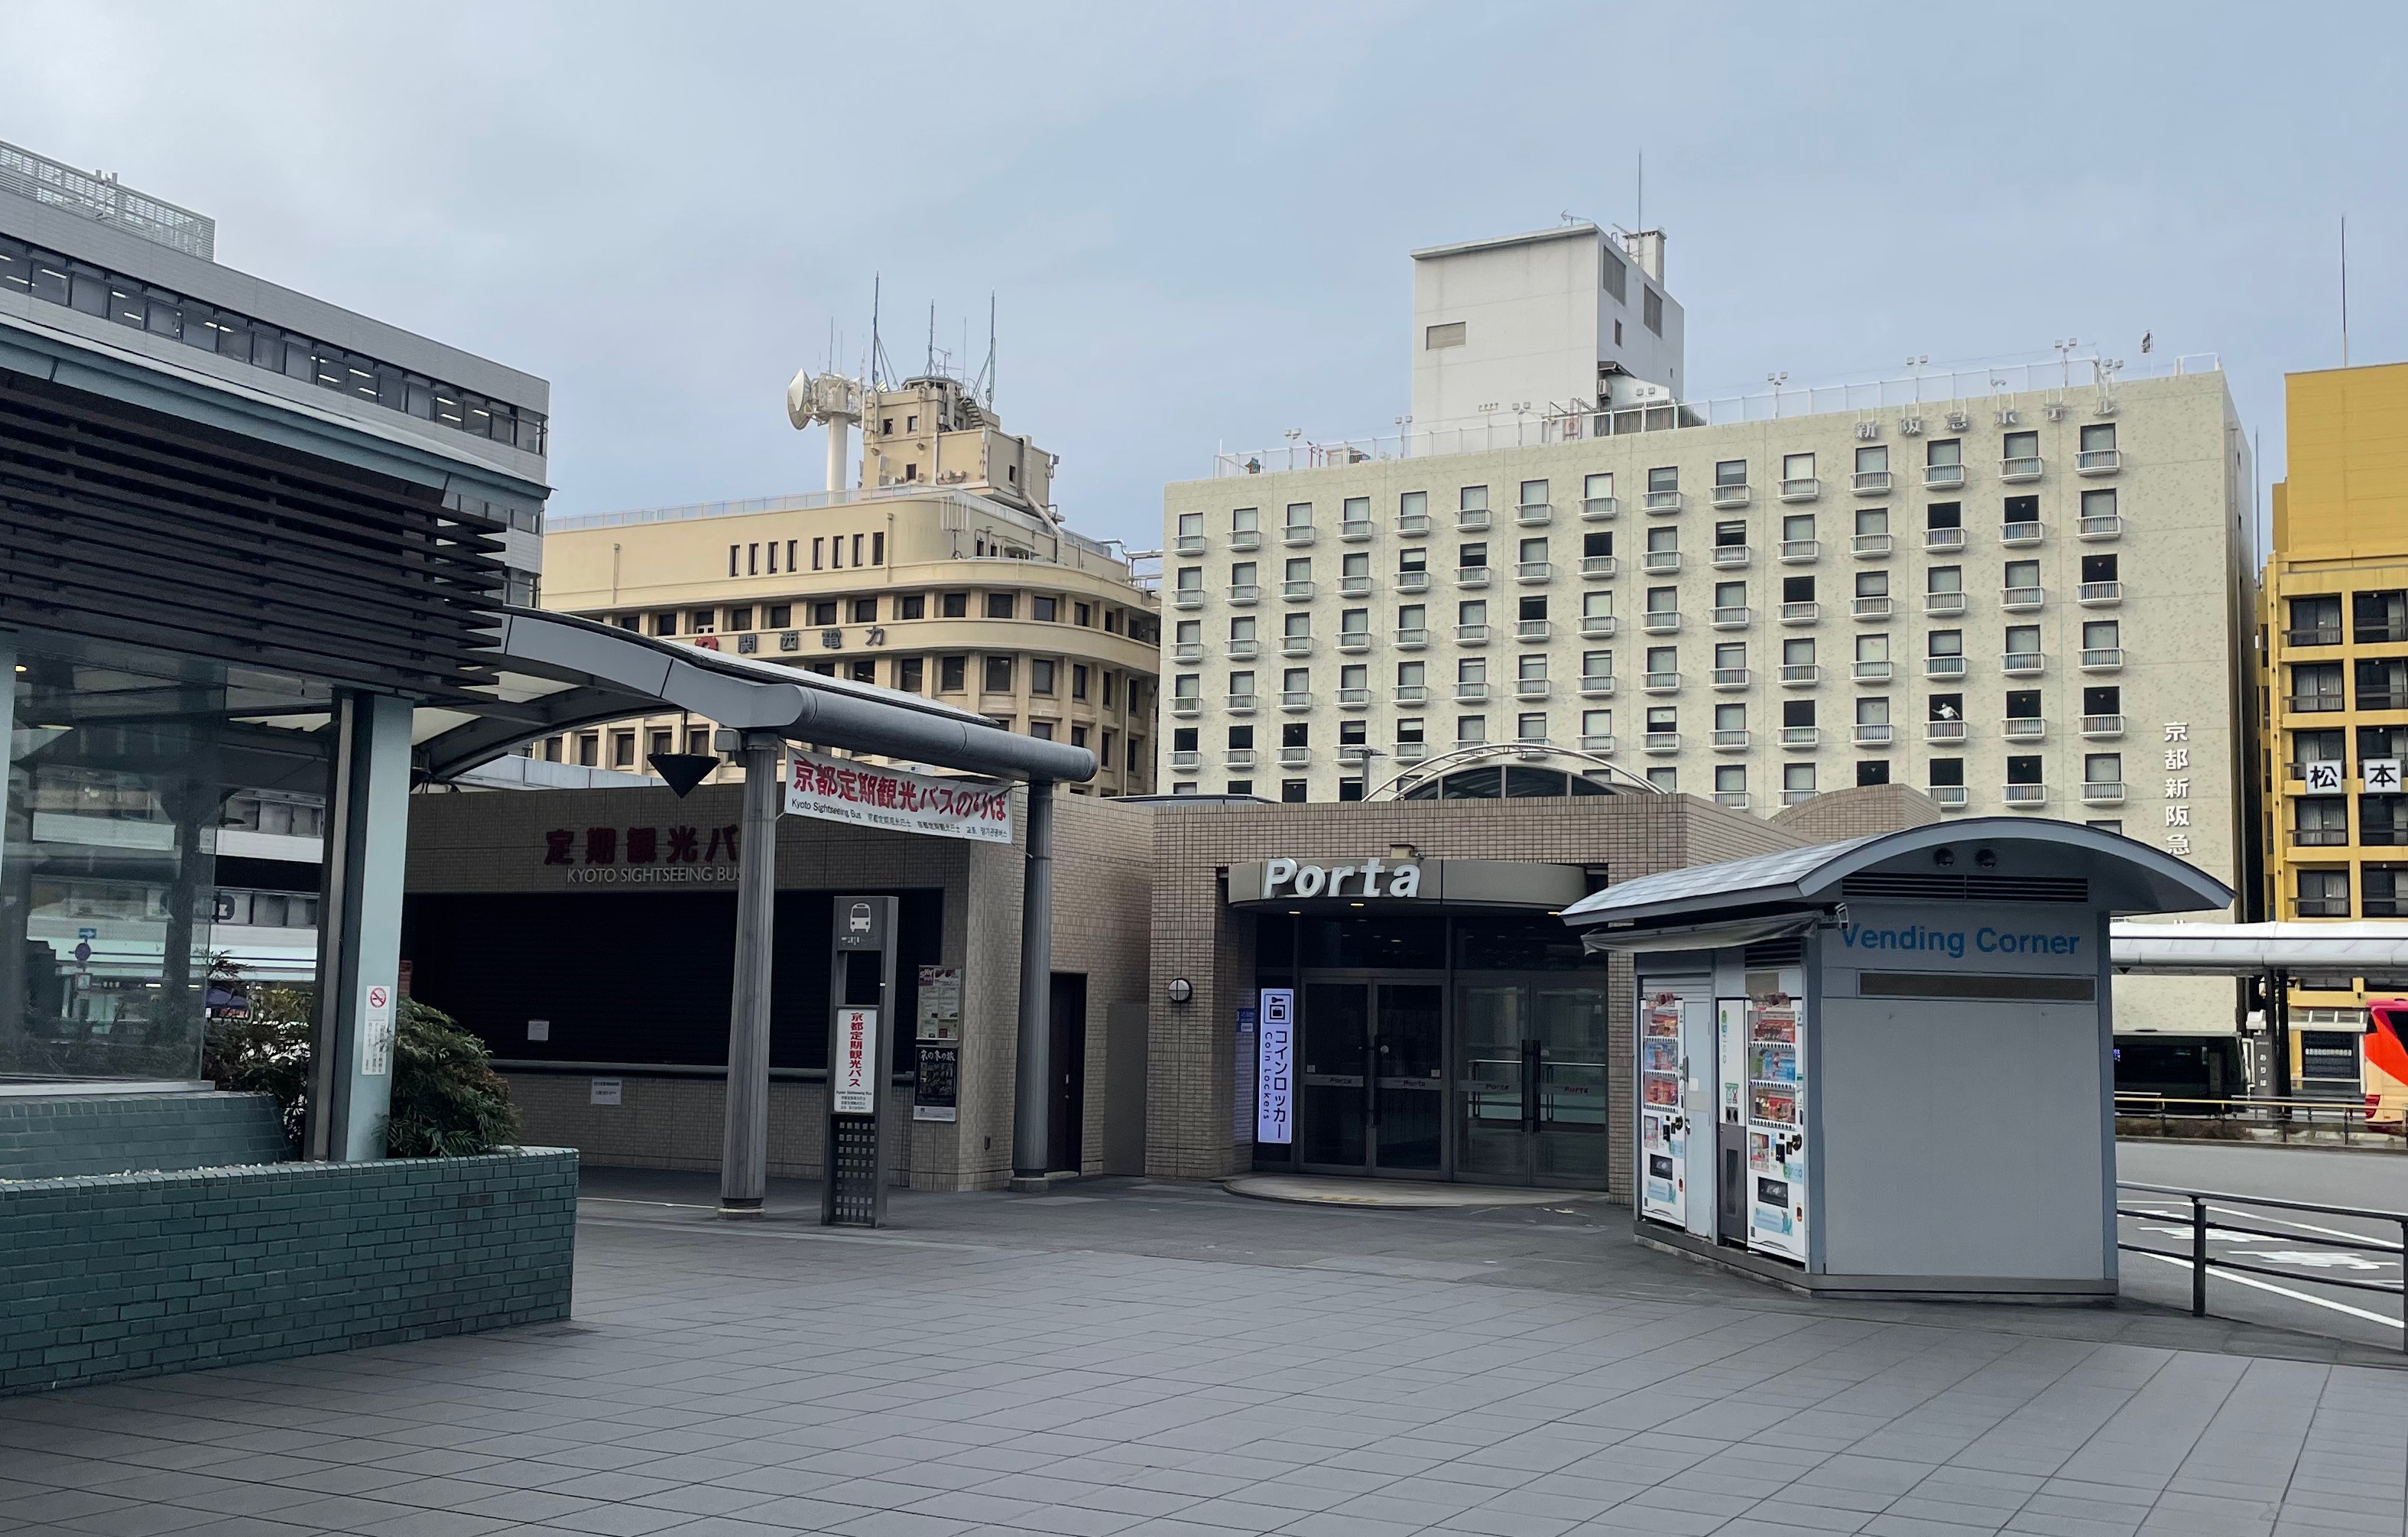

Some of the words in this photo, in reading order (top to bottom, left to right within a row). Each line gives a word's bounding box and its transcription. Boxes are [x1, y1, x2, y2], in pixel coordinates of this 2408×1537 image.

[737, 626, 885, 654] 関西電力
[793, 759, 1008, 821] 京都定期観光バスのりば
[2163, 720, 2191, 855] 京都新阪急
[2309, 763, 2397, 789] 松本
[791, 798, 812, 810] Kyoto
[813, 801, 850, 818] Sightseeing
[850, 809, 862, 820] Bus
[566, 867, 616, 883] KYOTO
[620, 866, 712, 882] SIGHTSEEING
[1263, 857, 1421, 898] Porta
[1841, 923, 1965, 959] Vending
[1975, 926, 2081, 955] Corner
[849, 1012, 865, 1087] 京都定期観光バス
[1264, 1032, 1273, 1061] Coin
[1263, 1069, 1272, 1119] Lockers
[1273, 1030, 1288, 1139] コインロッカー
